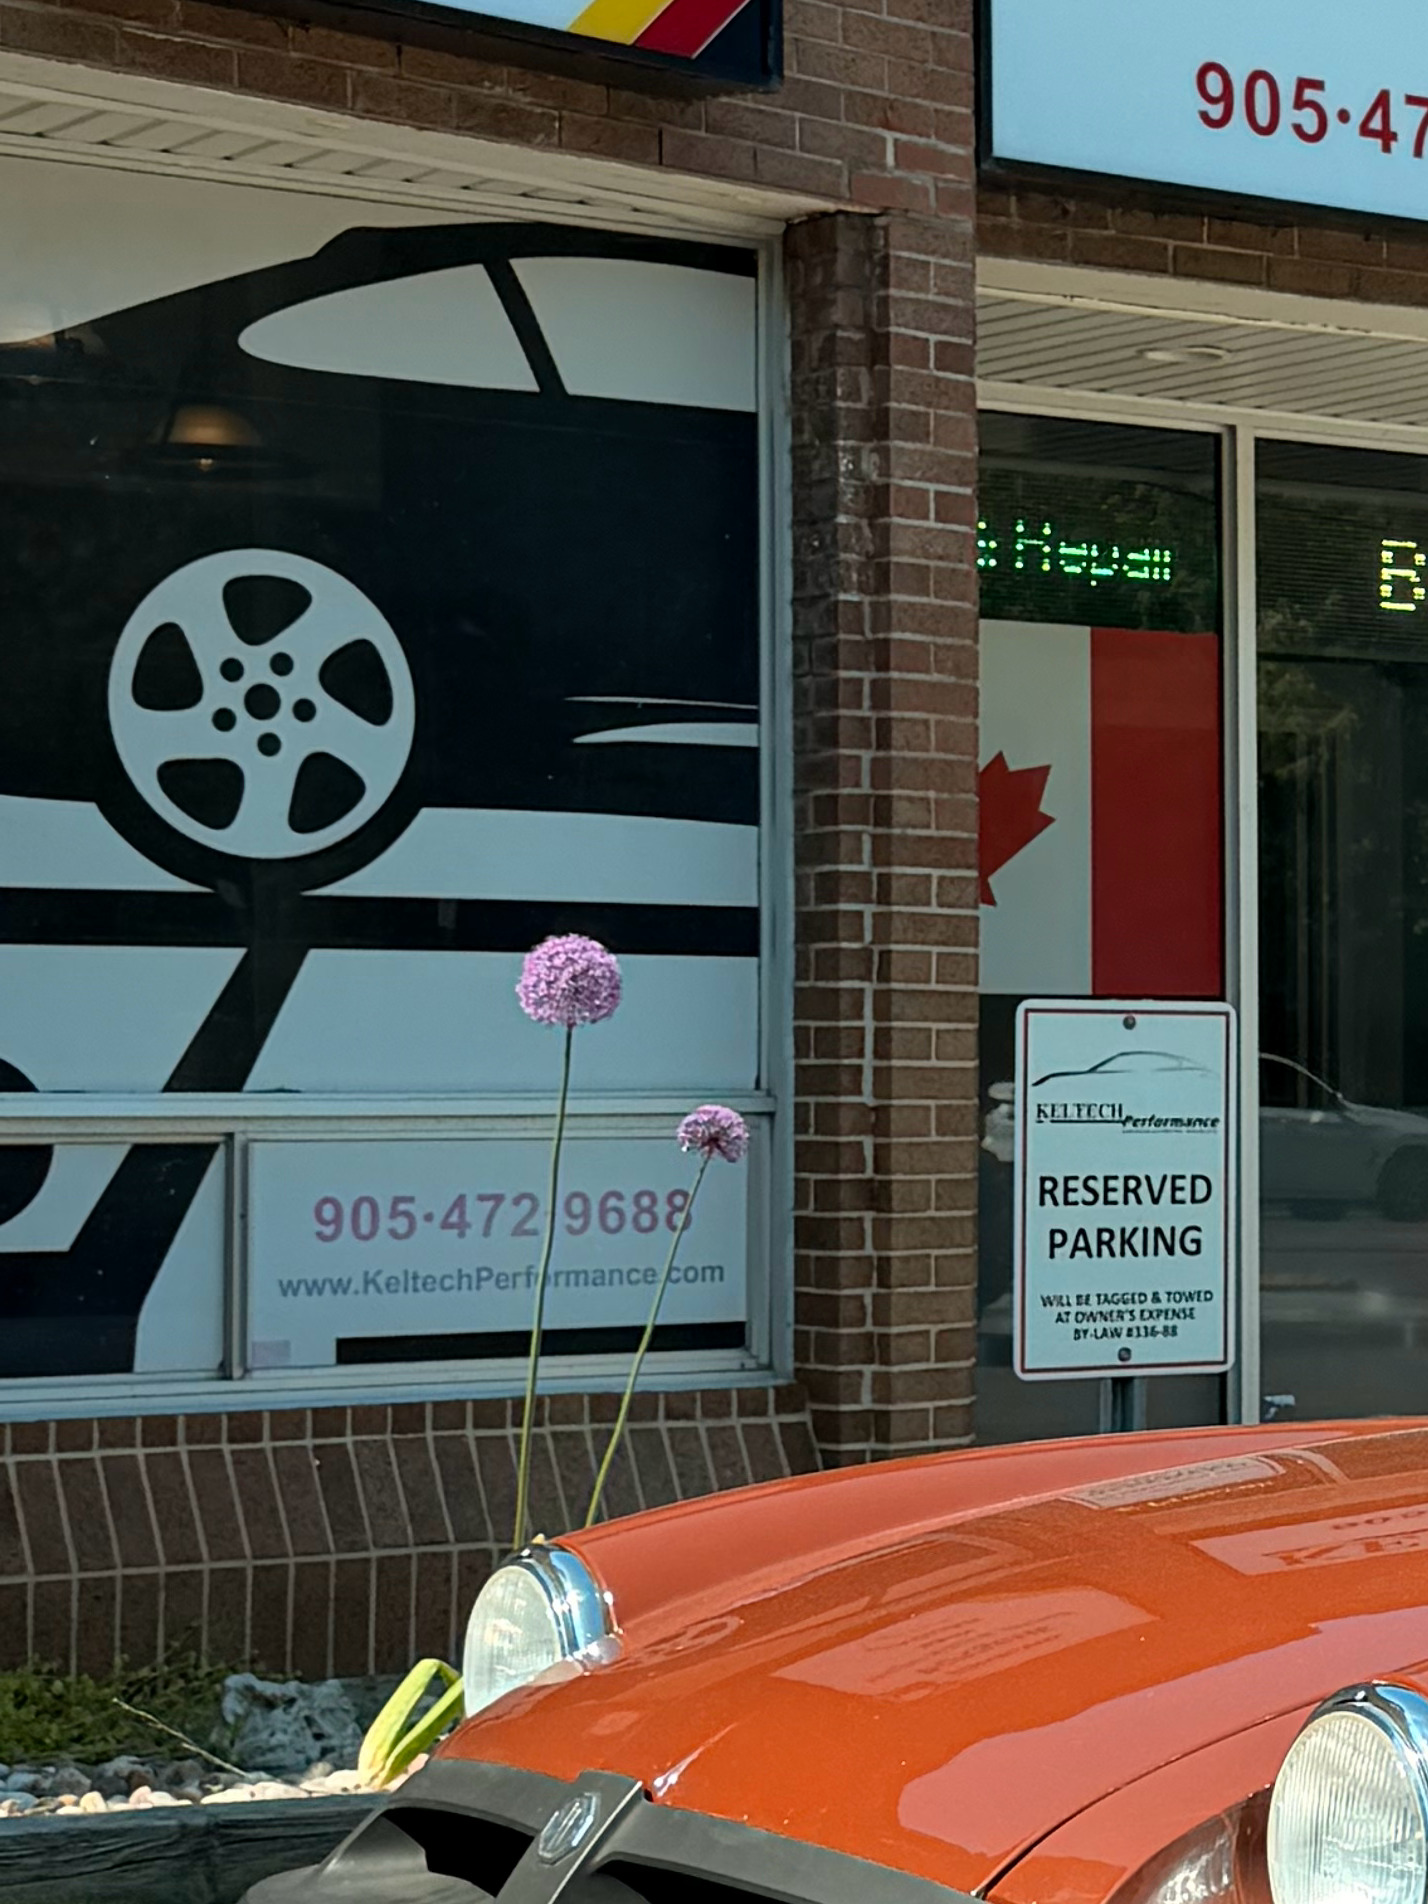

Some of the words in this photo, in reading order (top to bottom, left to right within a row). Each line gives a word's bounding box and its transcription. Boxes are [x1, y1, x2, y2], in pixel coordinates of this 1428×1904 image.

[1036, 1102, 1123, 1120] KELTECH
[1122, 1114, 1220, 1129] Performance
[1038, 1173, 1213, 1207] RESERVED
[312, 1187, 693, 1242] 905·4729688
[1048, 1225, 1204, 1259] PARKING
[278, 1262, 725, 1298] www.KeltechPerfrmancecom
[1040, 1293, 1073, 1309] WILL
[1075, 1293, 1092, 1307] BE
[1096, 1291, 1148, 1307] TAGGED
[1150, 1291, 1163, 1305] &
[1164, 1289, 1214, 1303] TOWED
[1055, 1310, 1072, 1325] AT
[1074, 1308, 1136, 1325] OWNER'S
[1139, 1306, 1196, 1321] EXPENSE
[1073, 1327, 1123, 1341] BY-LAW
